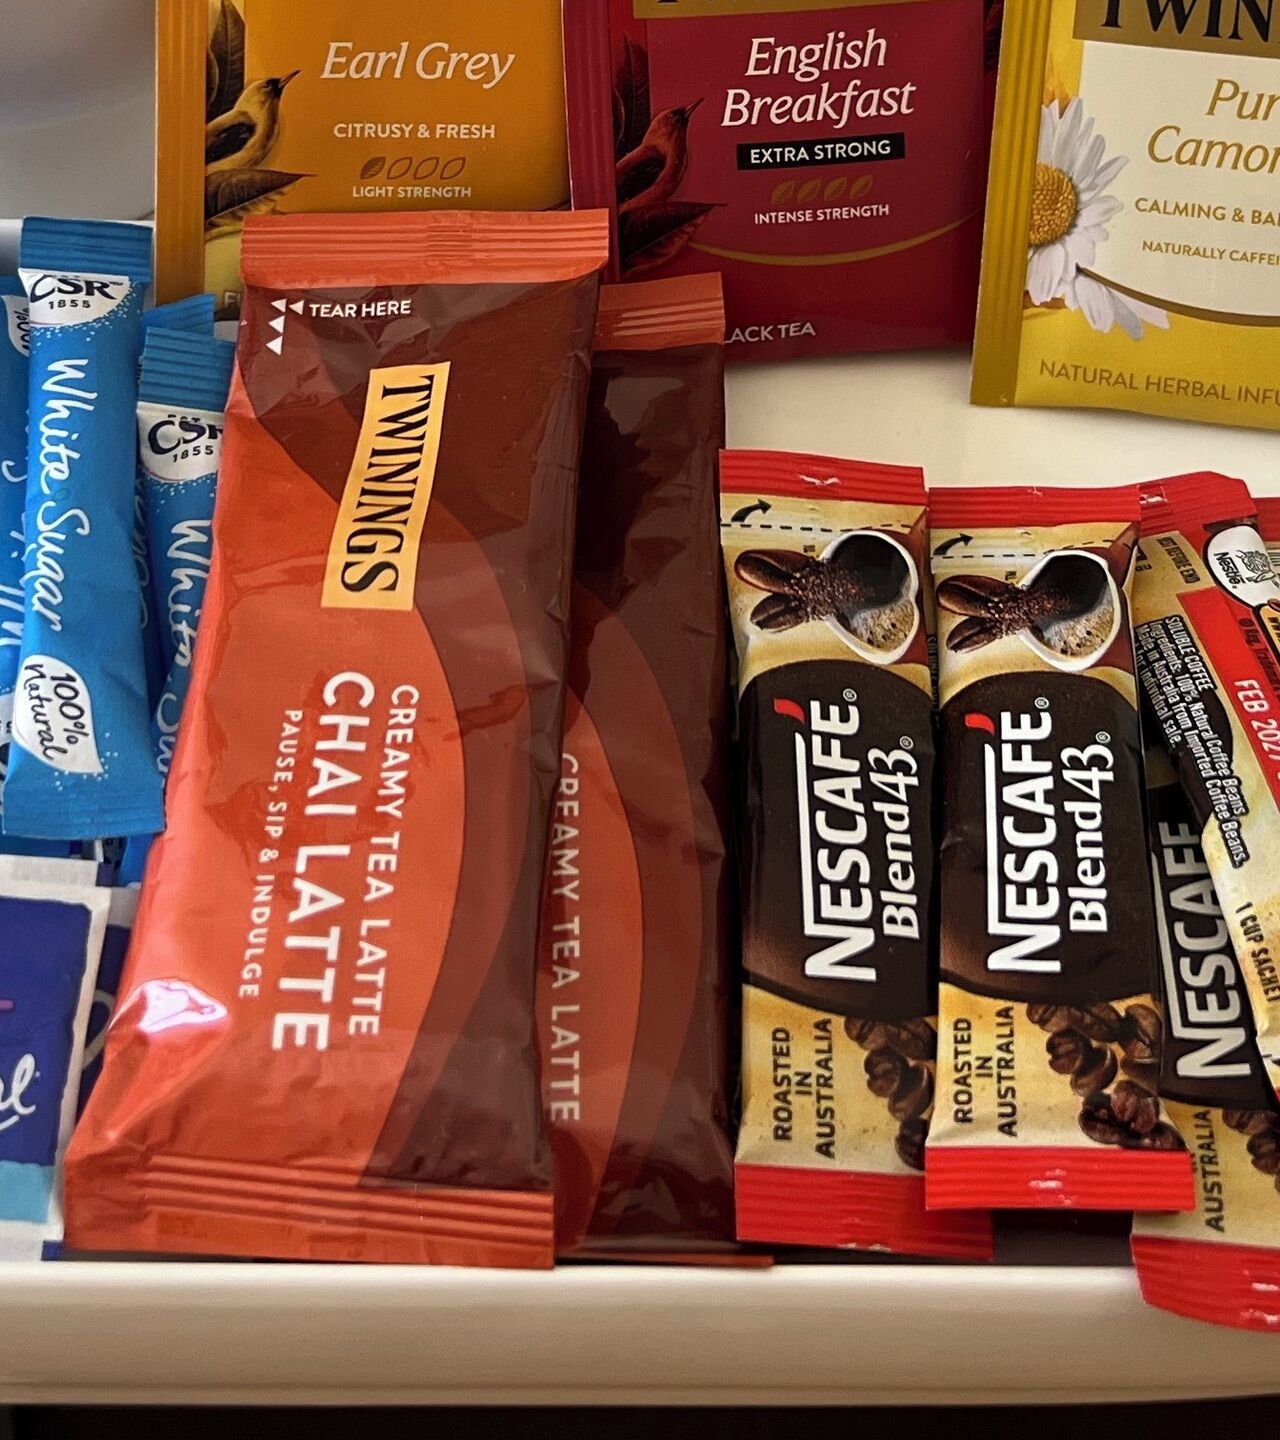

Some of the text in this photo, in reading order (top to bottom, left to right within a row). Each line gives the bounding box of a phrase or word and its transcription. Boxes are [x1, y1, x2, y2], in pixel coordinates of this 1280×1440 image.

[321, 41, 514, 90] Earl Grey
[745, 28, 887, 78] English
[722, 81, 916, 128] Breakfast
[333, 122, 496, 140] CITRUSY & FRESH
[750, 140, 891, 164] EXTRA STRONG
[352, 185, 471, 199] LIGHT STRENGTH
[754, 204, 889, 225] INTENSE STRENGTH
[1135, 197, 1228, 222] CALMING
[1232, 205, 1244, 223] &
[1142, 240, 1225, 261] NATURALLY
[309, 298, 410, 318] TEAR HERE
[776, 322, 815, 340] TEA
[1039, 359, 1139, 392] NATURAL
[1145, 375, 1230, 403] HERBAL
[32, 359, 98, 632] White Sugar
[341, 373, 436, 597] TWININGS
[1166, 616, 1196, 655] SOLUBLE
[1185, 654, 1214, 690] COFFEE
[24, 664, 62, 760] Natural
[50, 672, 90, 745] 100%
[1235, 679, 1269, 713] FEB
[239, 709, 304, 999] PAUSE, SIP & INDULGE
[271, 671, 376, 1051] CHAI LATTE
[348, 683, 420, 1036] CREAMY TEA LATTE
[550, 752, 581, 1123] CREAMY TEA LATTE
[1239, 914, 1263, 943] CUP
[771, 1026, 793, 1144] ROASTED
[794, 1070, 812, 1106] IN
[814, 1018, 836, 1159] AUSTRALIA
[952, 1018, 974, 1126] ROASTED
[977, 1055, 992, 1082] IN
[994, 1006, 1017, 1137] AUSTRALIA
[1194, 1110, 1225, 1232] AUSTRALIA
